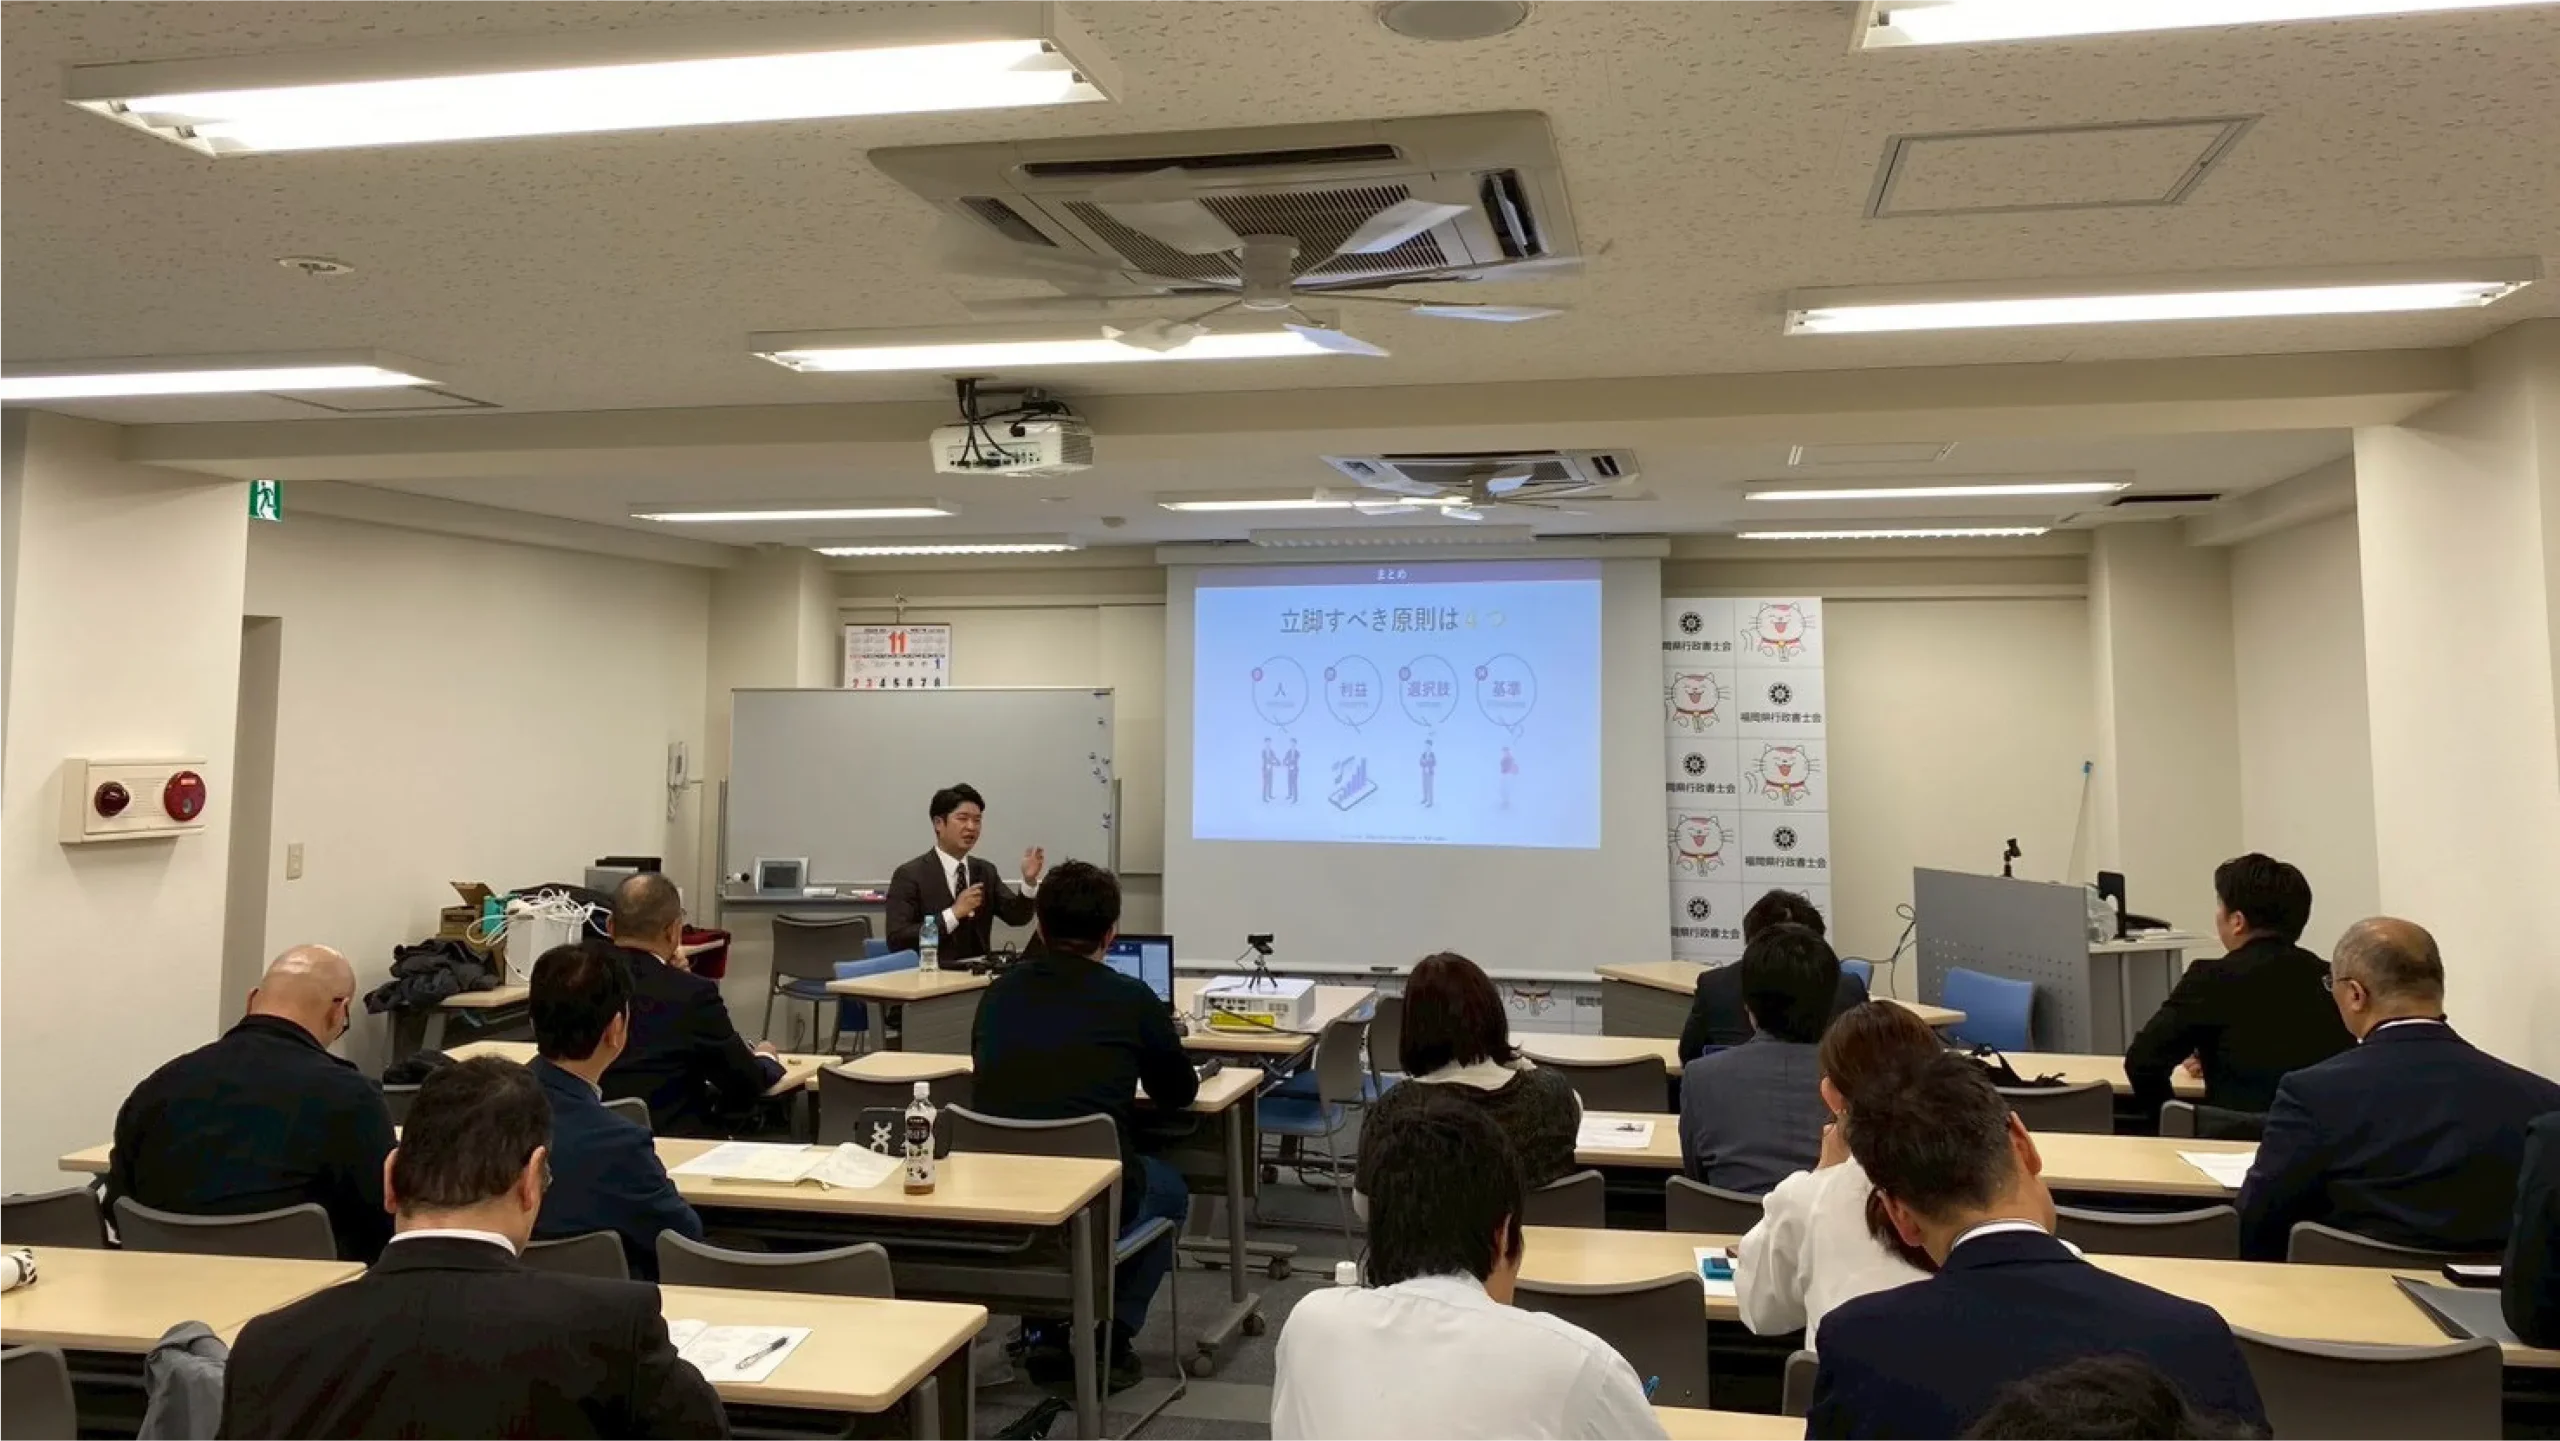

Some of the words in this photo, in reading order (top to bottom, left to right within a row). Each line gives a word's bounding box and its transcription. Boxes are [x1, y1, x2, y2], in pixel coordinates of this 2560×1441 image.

[1376, 568, 1407, 580] まとめ
[889, 632, 906, 653] 11
[935, 658, 941, 670] 1
[921, 678, 927, 688] 7
[1274, 682, 1287, 698] 人
[1339, 682, 1369, 698] 利益
[1740, 711, 1823, 724] 福岡県行政書士会
[1745, 855, 1828, 869] 福岡県行政書士会
